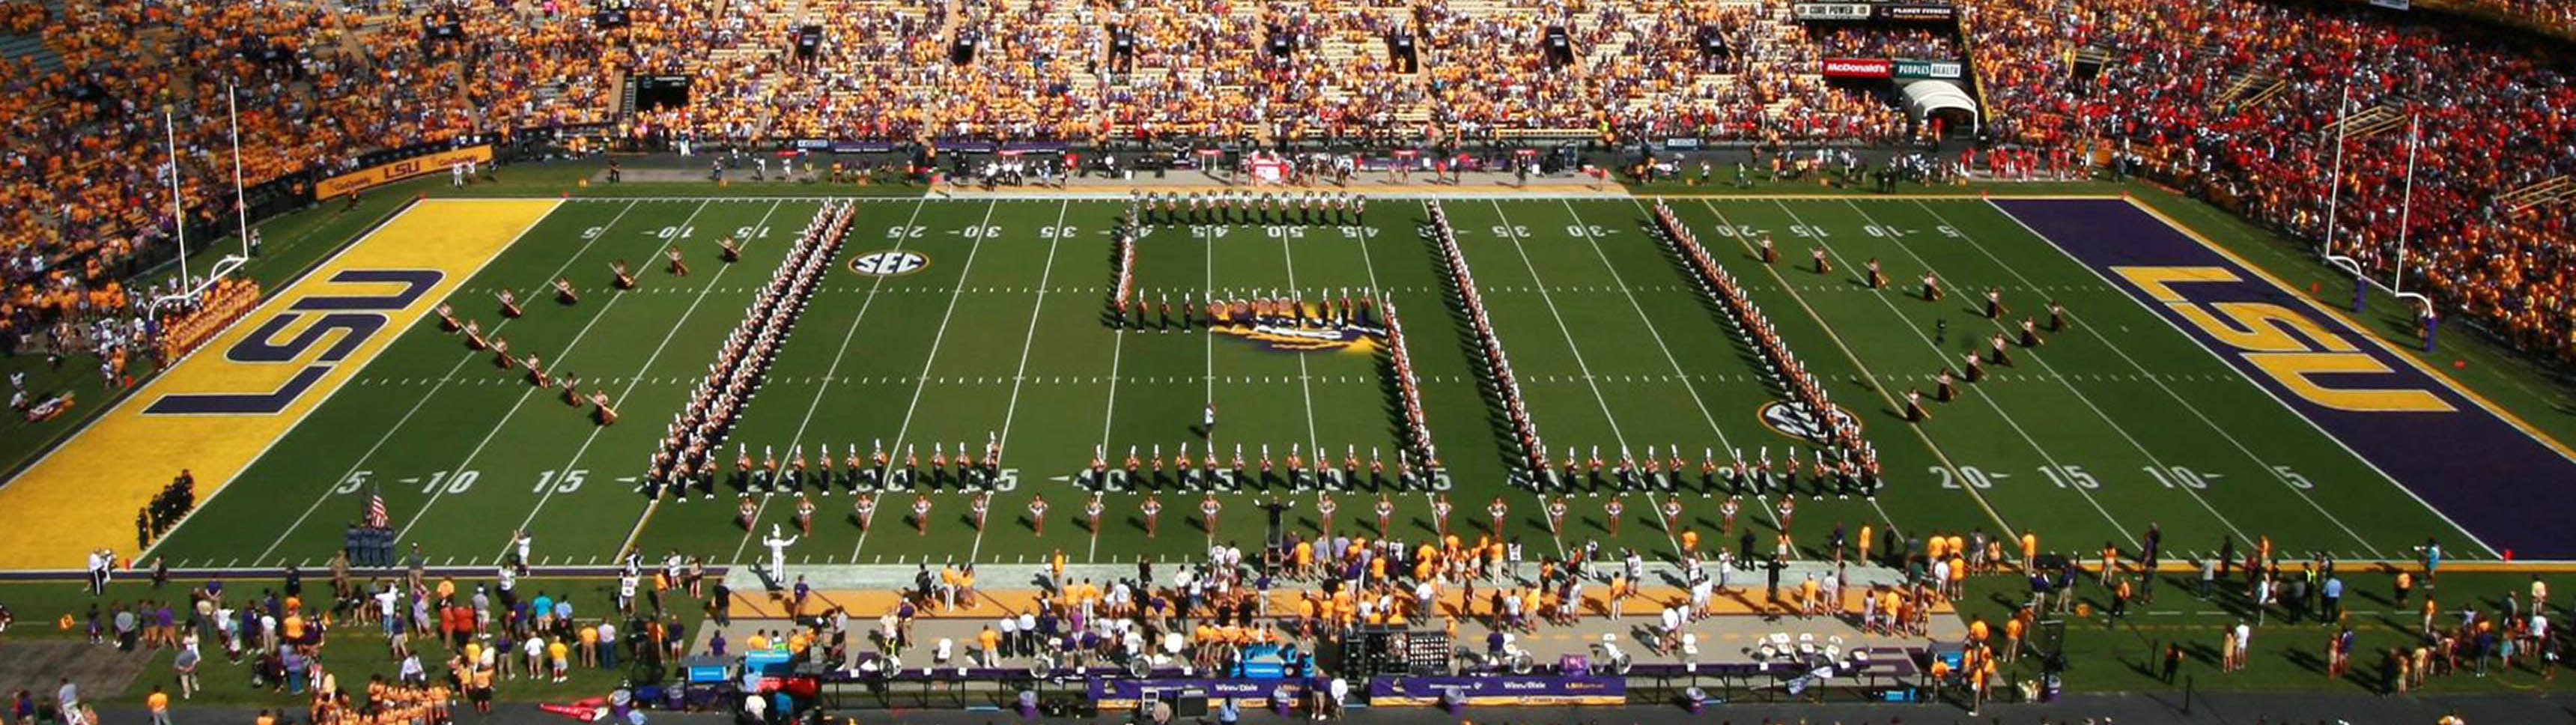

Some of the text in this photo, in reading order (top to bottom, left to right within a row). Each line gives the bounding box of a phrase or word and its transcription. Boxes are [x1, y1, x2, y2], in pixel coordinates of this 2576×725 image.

[1829, 5, 1853, 14] POWER
[1827, 62, 1886, 73] McDonald's
[1898, 64, 1959, 75] PEOPLES HEALTH
[384, 161, 421, 179] LSU
[581, 226, 601, 239] 5
[657, 226, 694, 238] 10
[735, 226, 770, 239] 15
[887, 225, 927, 238] 25
[964, 225, 1002, 238] 30
[1039, 225, 1078, 238] 35
[1191, 225, 1229, 238] 45
[1267, 225, 1304, 238] 50
[1342, 225, 1379, 238] 45
[1492, 225, 1531, 238] 35
[1567, 225, 1606, 237] 30
[1716, 225, 1758, 237] 20
[1790, 225, 1830, 237] 15
[1863, 225, 1904, 237] 10
[1937, 225, 1959, 238] 5
[854, 252, 924, 276] SEC
[141, 269, 448, 415] LSU
[2108, 267, 2459, 412] LSU
[336, 470, 373, 494] 5
[422, 470, 480, 494] 10
[532, 470, 589, 494] 15
[1928, 465, 1992, 489] 20
[2037, 466, 2100, 489] 15
[2142, 466, 2208, 490] 10
[2273, 465, 2314, 489] 5
